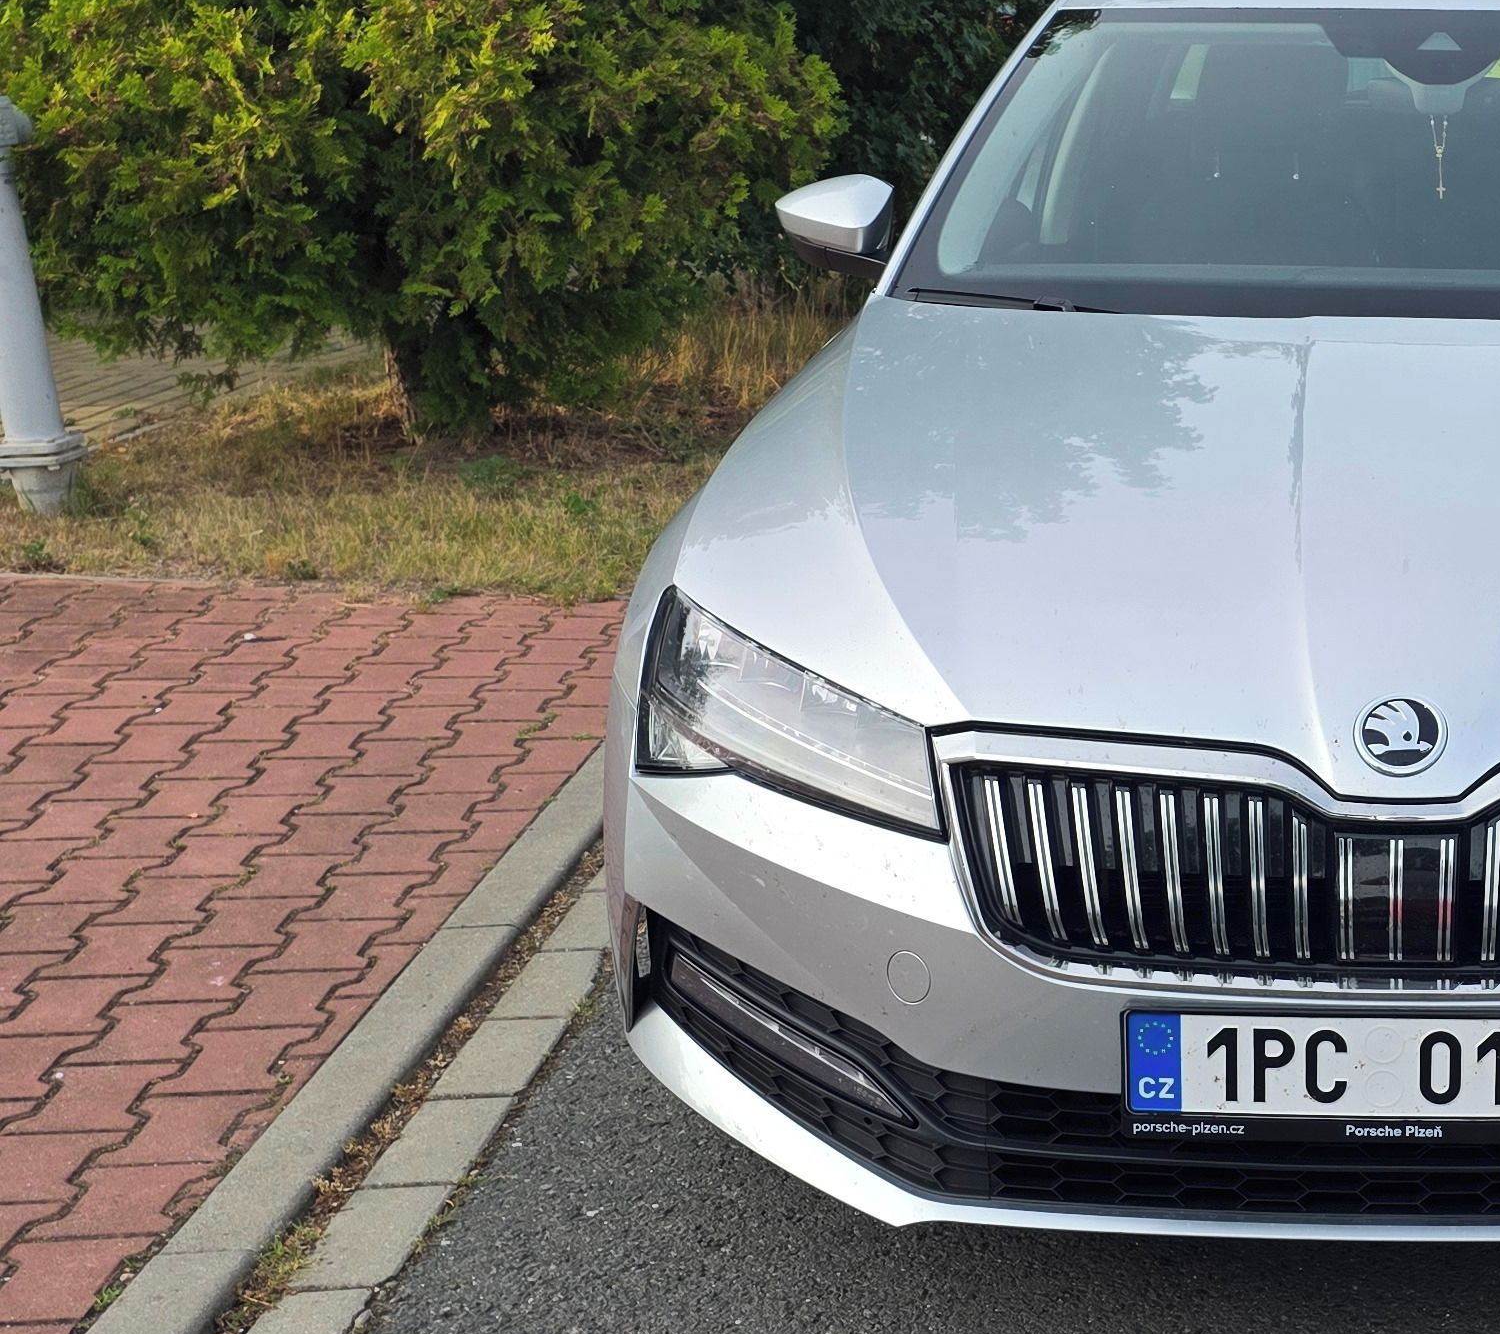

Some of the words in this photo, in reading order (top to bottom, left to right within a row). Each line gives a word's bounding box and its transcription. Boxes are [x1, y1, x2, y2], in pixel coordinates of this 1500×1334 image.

[1206, 1027, 1348, 1104] 1PC
[1138, 1076, 1175, 1099] CZ
[1132, 1121, 1245, 1136] porsche-plzen.cz
[1345, 1124, 1403, 1137] Porsche
[1405, 1125, 1443, 1138] Plzeň
